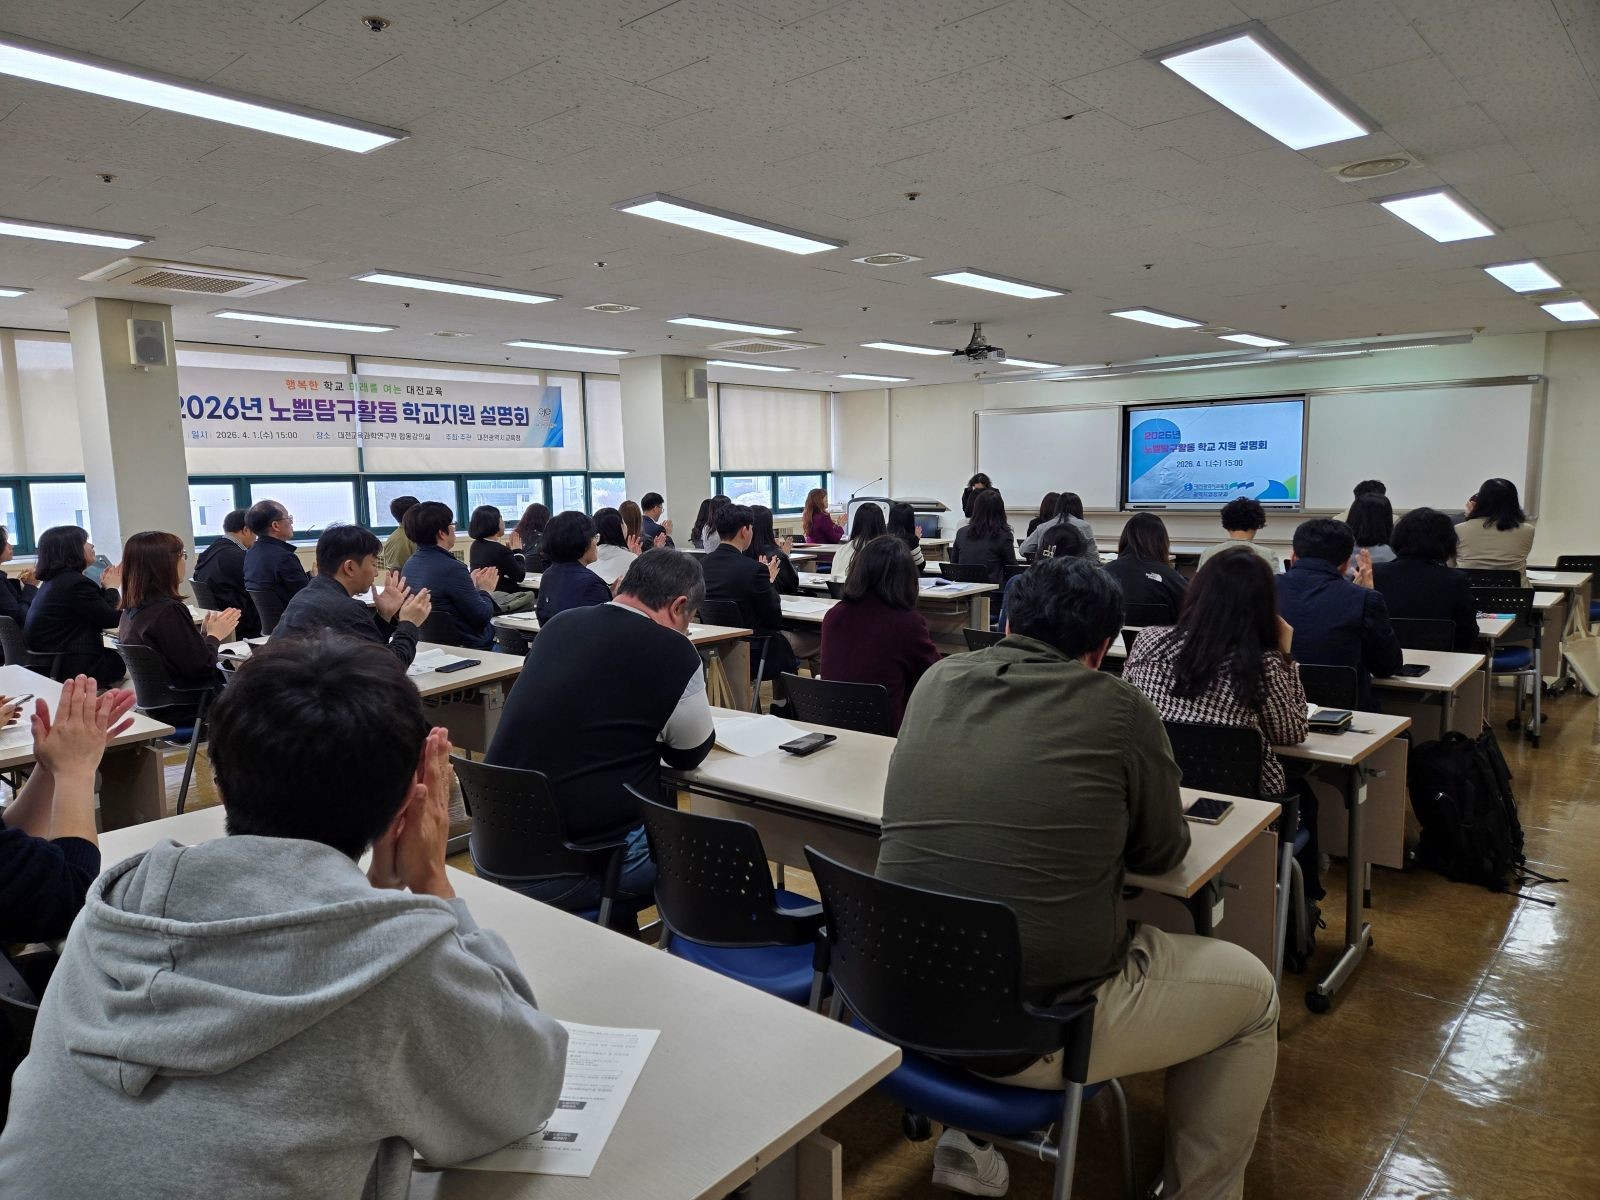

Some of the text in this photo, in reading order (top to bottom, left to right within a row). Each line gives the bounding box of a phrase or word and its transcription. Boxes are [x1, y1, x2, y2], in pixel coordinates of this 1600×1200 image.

[286, 379, 443, 397] 행복한 학교 미래를 여는 대전교육
[268, 397, 398, 424] 노벨탐구활동
[402, 401, 476, 426] 학교지원
[480, 405, 530, 427] 설명회
[192, 430, 208, 440] 일시
[216, 431, 240, 439] 2026.
[242, 431, 250, 439] 4.
[276, 431, 298, 439] 15:00
[316, 431, 330, 440] 장소
[1144, 430, 1181, 440] 2026년
[1198, 442, 1216, 452] 학교
[1218, 441, 1237, 451] 지원
[1239, 440, 1268, 450] 설명회
[1176, 460, 1195, 468] 2026.
